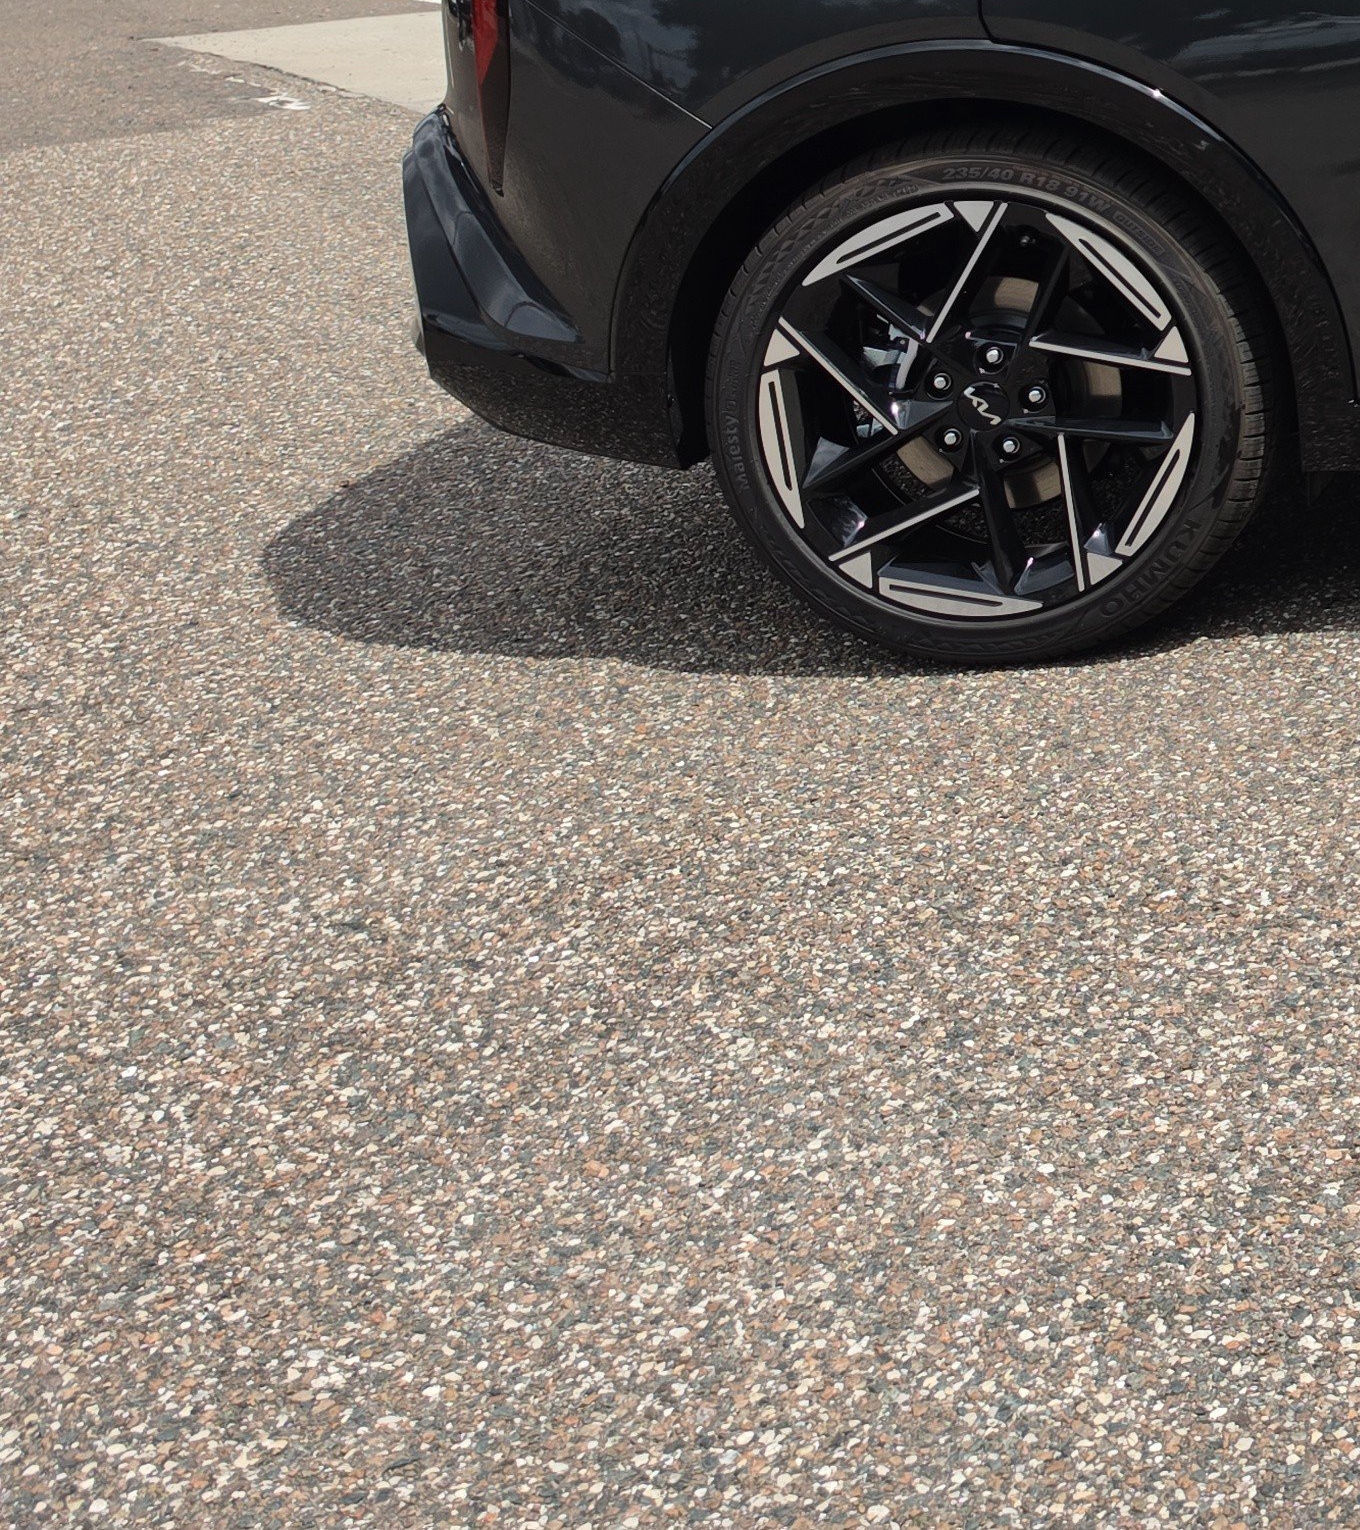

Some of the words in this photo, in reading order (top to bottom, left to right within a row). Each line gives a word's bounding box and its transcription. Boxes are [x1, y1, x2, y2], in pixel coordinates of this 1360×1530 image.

[943, 166, 1016, 183] 235/40
[1020, 173, 1059, 192] R18
[1063, 184, 1110, 212] 91W
[964, 386, 1002, 425] KIA
[1100, 520, 1201, 618] KUMHO
